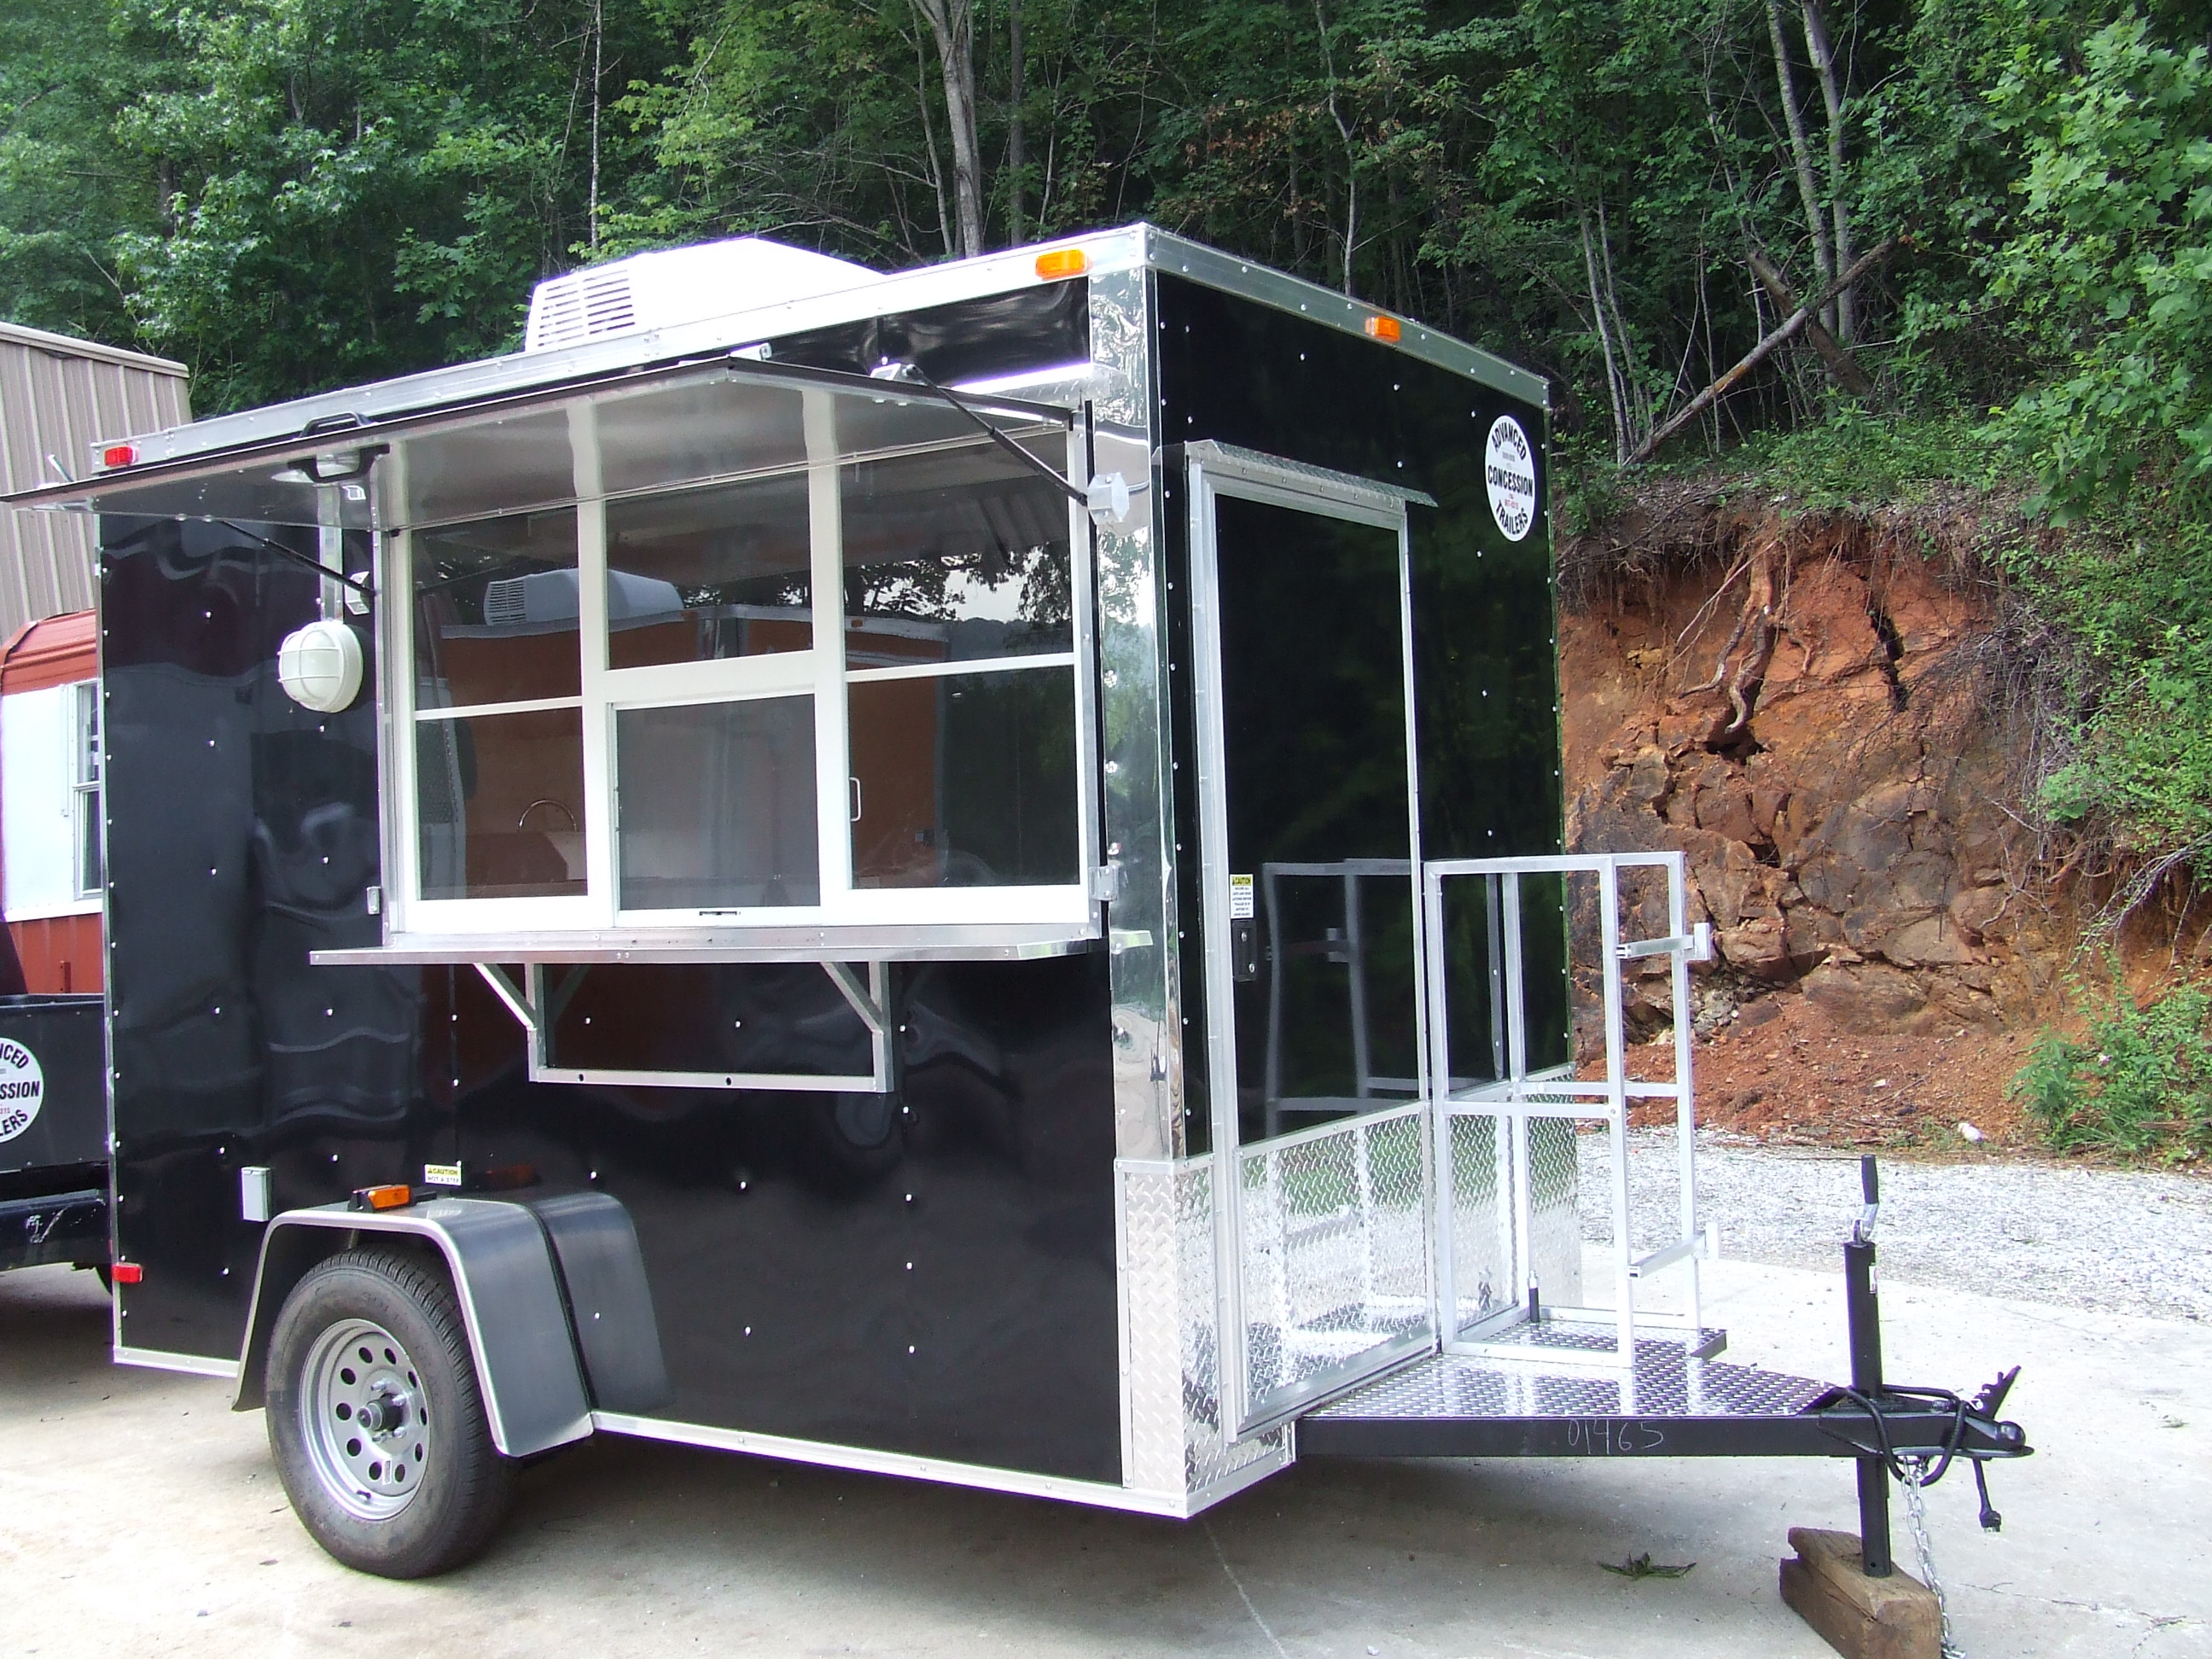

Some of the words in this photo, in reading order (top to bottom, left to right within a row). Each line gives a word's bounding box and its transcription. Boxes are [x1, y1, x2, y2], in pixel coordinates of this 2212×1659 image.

[1492, 422, 1527, 461] ADVANCED
[1487, 464, 1534, 498] CONCESSION
[1496, 500, 1528, 535] TRAILERS
[433, 1167, 458, 1176] CAUTION
[1568, 1417, 1663, 1454] 01465
